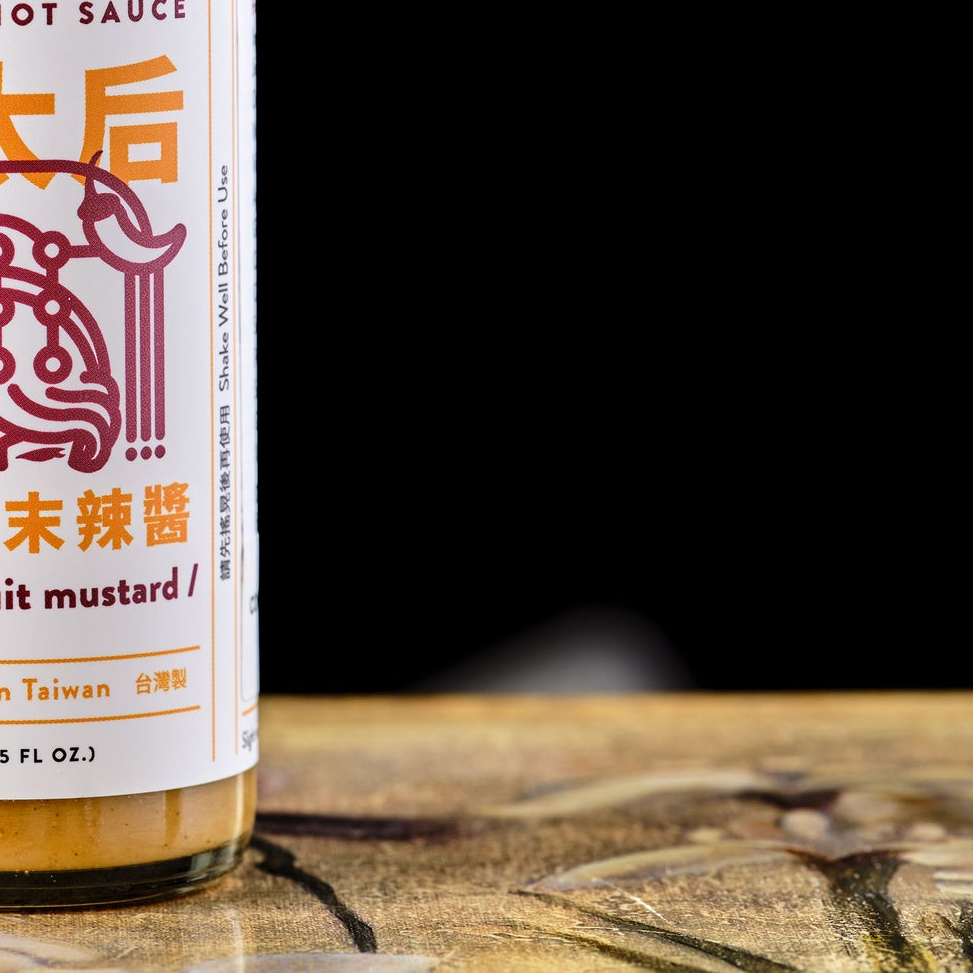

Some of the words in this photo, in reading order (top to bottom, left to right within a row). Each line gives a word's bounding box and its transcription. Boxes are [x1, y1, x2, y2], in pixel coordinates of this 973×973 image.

[217, 164, 228, 203] Use
[217, 209, 229, 276] Before
[218, 283, 229, 328] Well
[218, 332, 230, 392] Shake
[44, 567, 179, 610] mustard
[21, 677, 111, 702] Taiwan
[135, 667, 188, 695] 台灣製
[19, 748, 44, 764] FL
[51, 745, 97, 764] OZ.)
